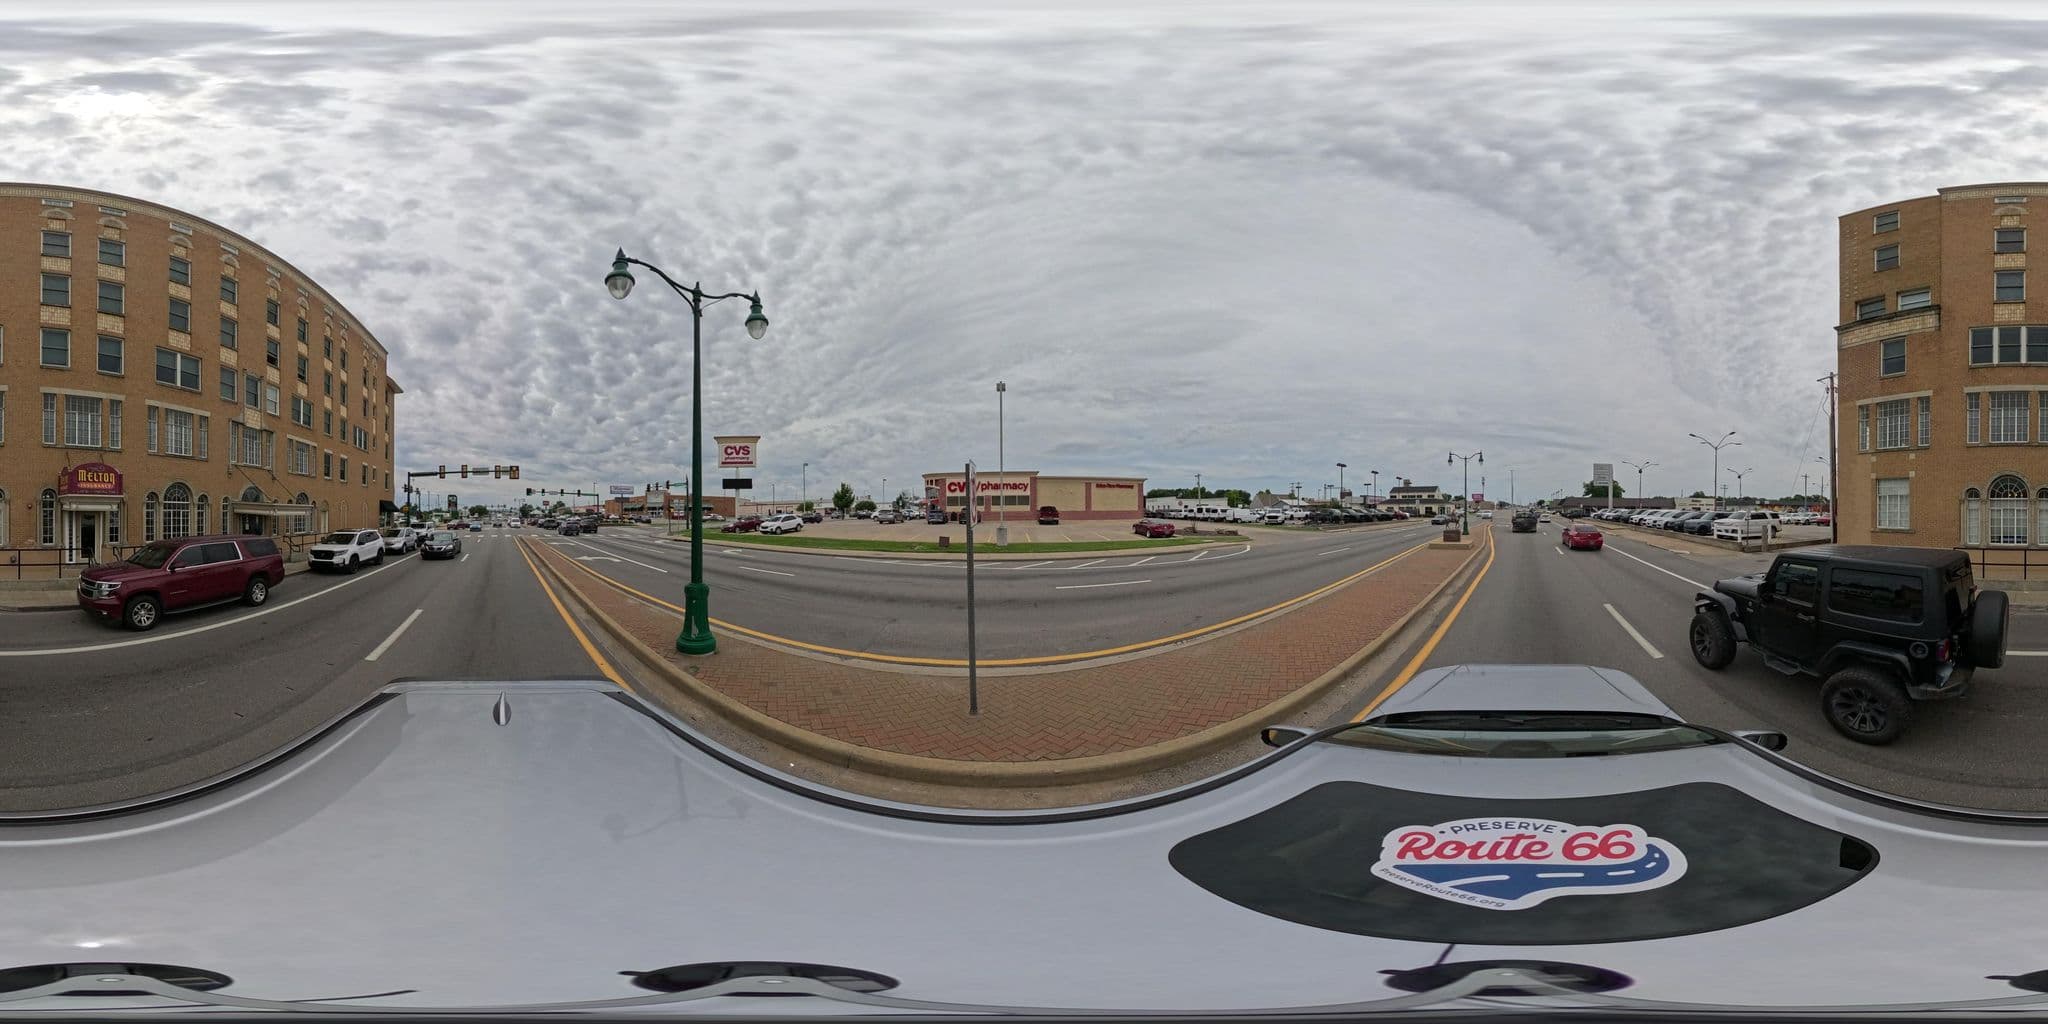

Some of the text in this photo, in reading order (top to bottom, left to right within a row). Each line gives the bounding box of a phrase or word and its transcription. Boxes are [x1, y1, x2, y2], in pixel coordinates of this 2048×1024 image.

[724, 445, 750, 456] CVS
[78, 469, 115, 485] MELTON
[1450, 821, 1558, 834] PRESERVE
[1396, 830, 1635, 861] Route 66
[1380, 867, 1505, 908] PreserveRoute66.org
